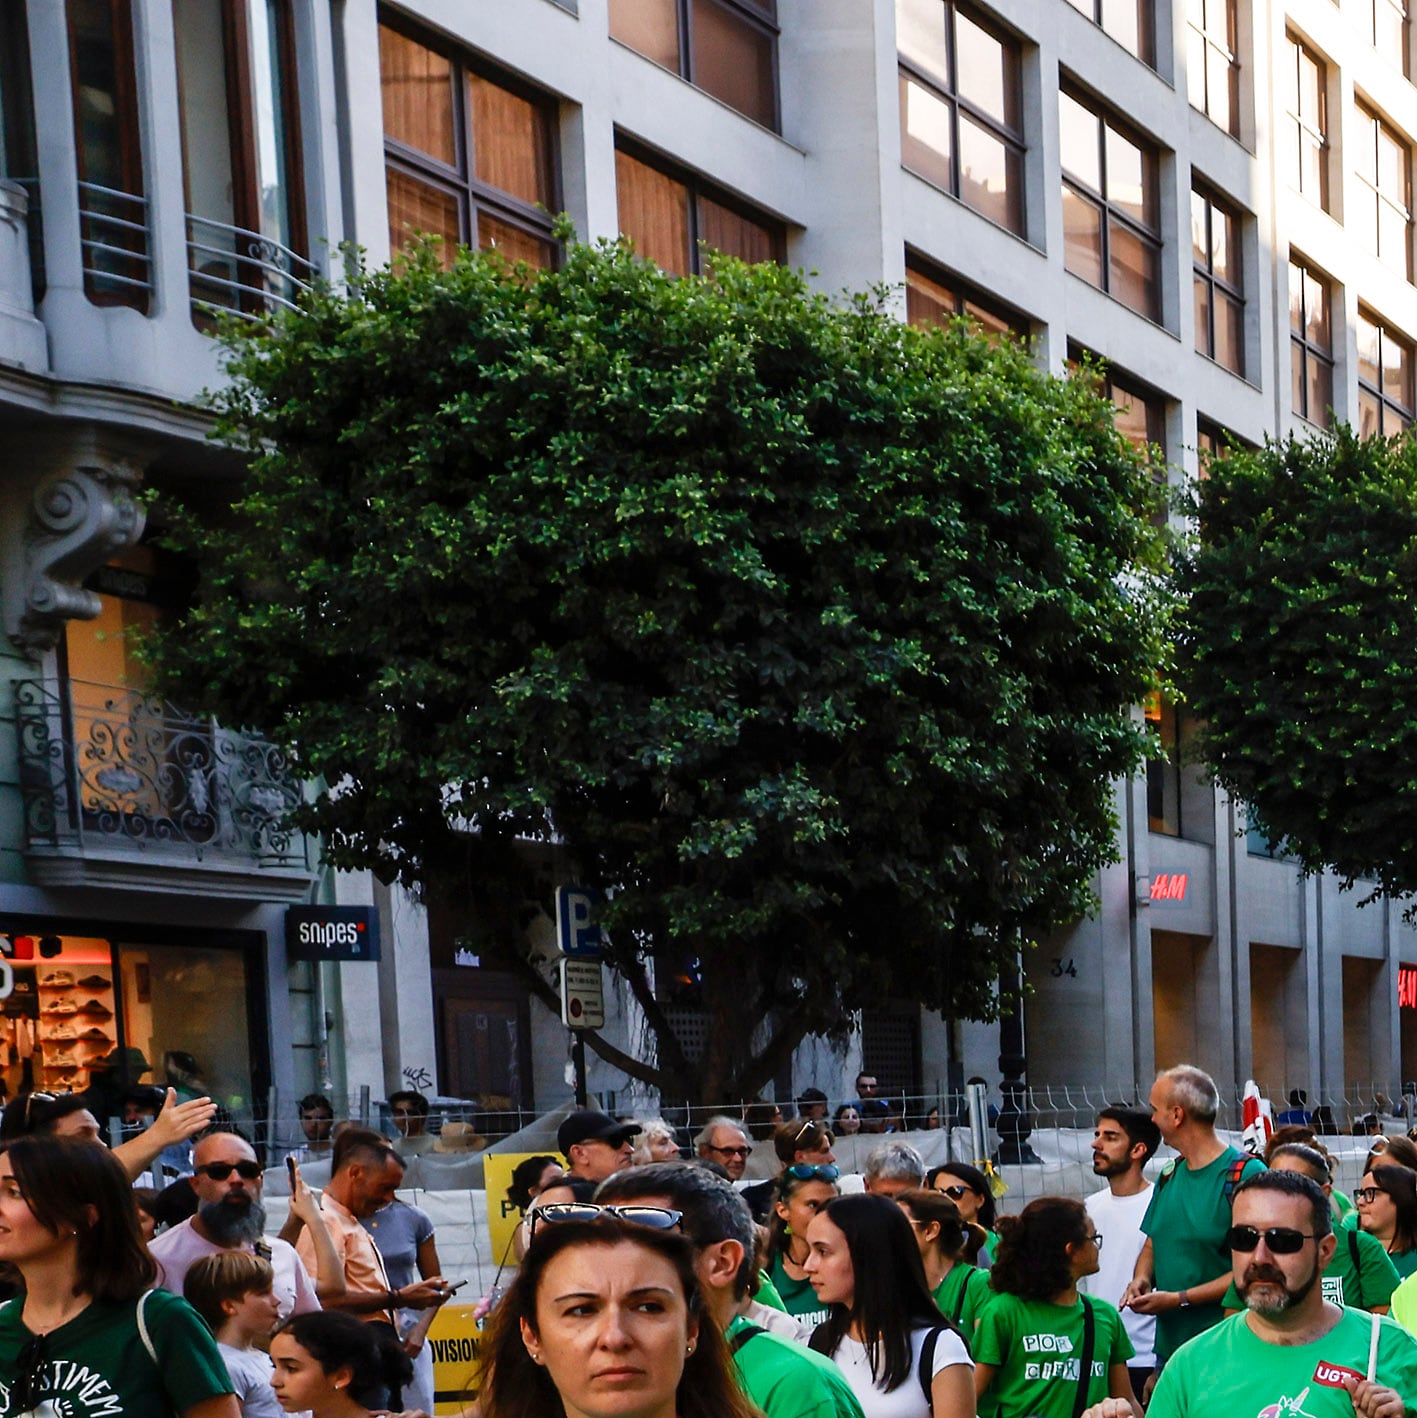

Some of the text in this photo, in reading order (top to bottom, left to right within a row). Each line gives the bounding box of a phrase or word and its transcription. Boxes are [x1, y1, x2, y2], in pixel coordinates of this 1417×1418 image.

[1150, 874, 1188, 900] H&M
[568, 893, 591, 948] P
[299, 921, 358, 948] snipes
[1051, 958, 1078, 978] 34
